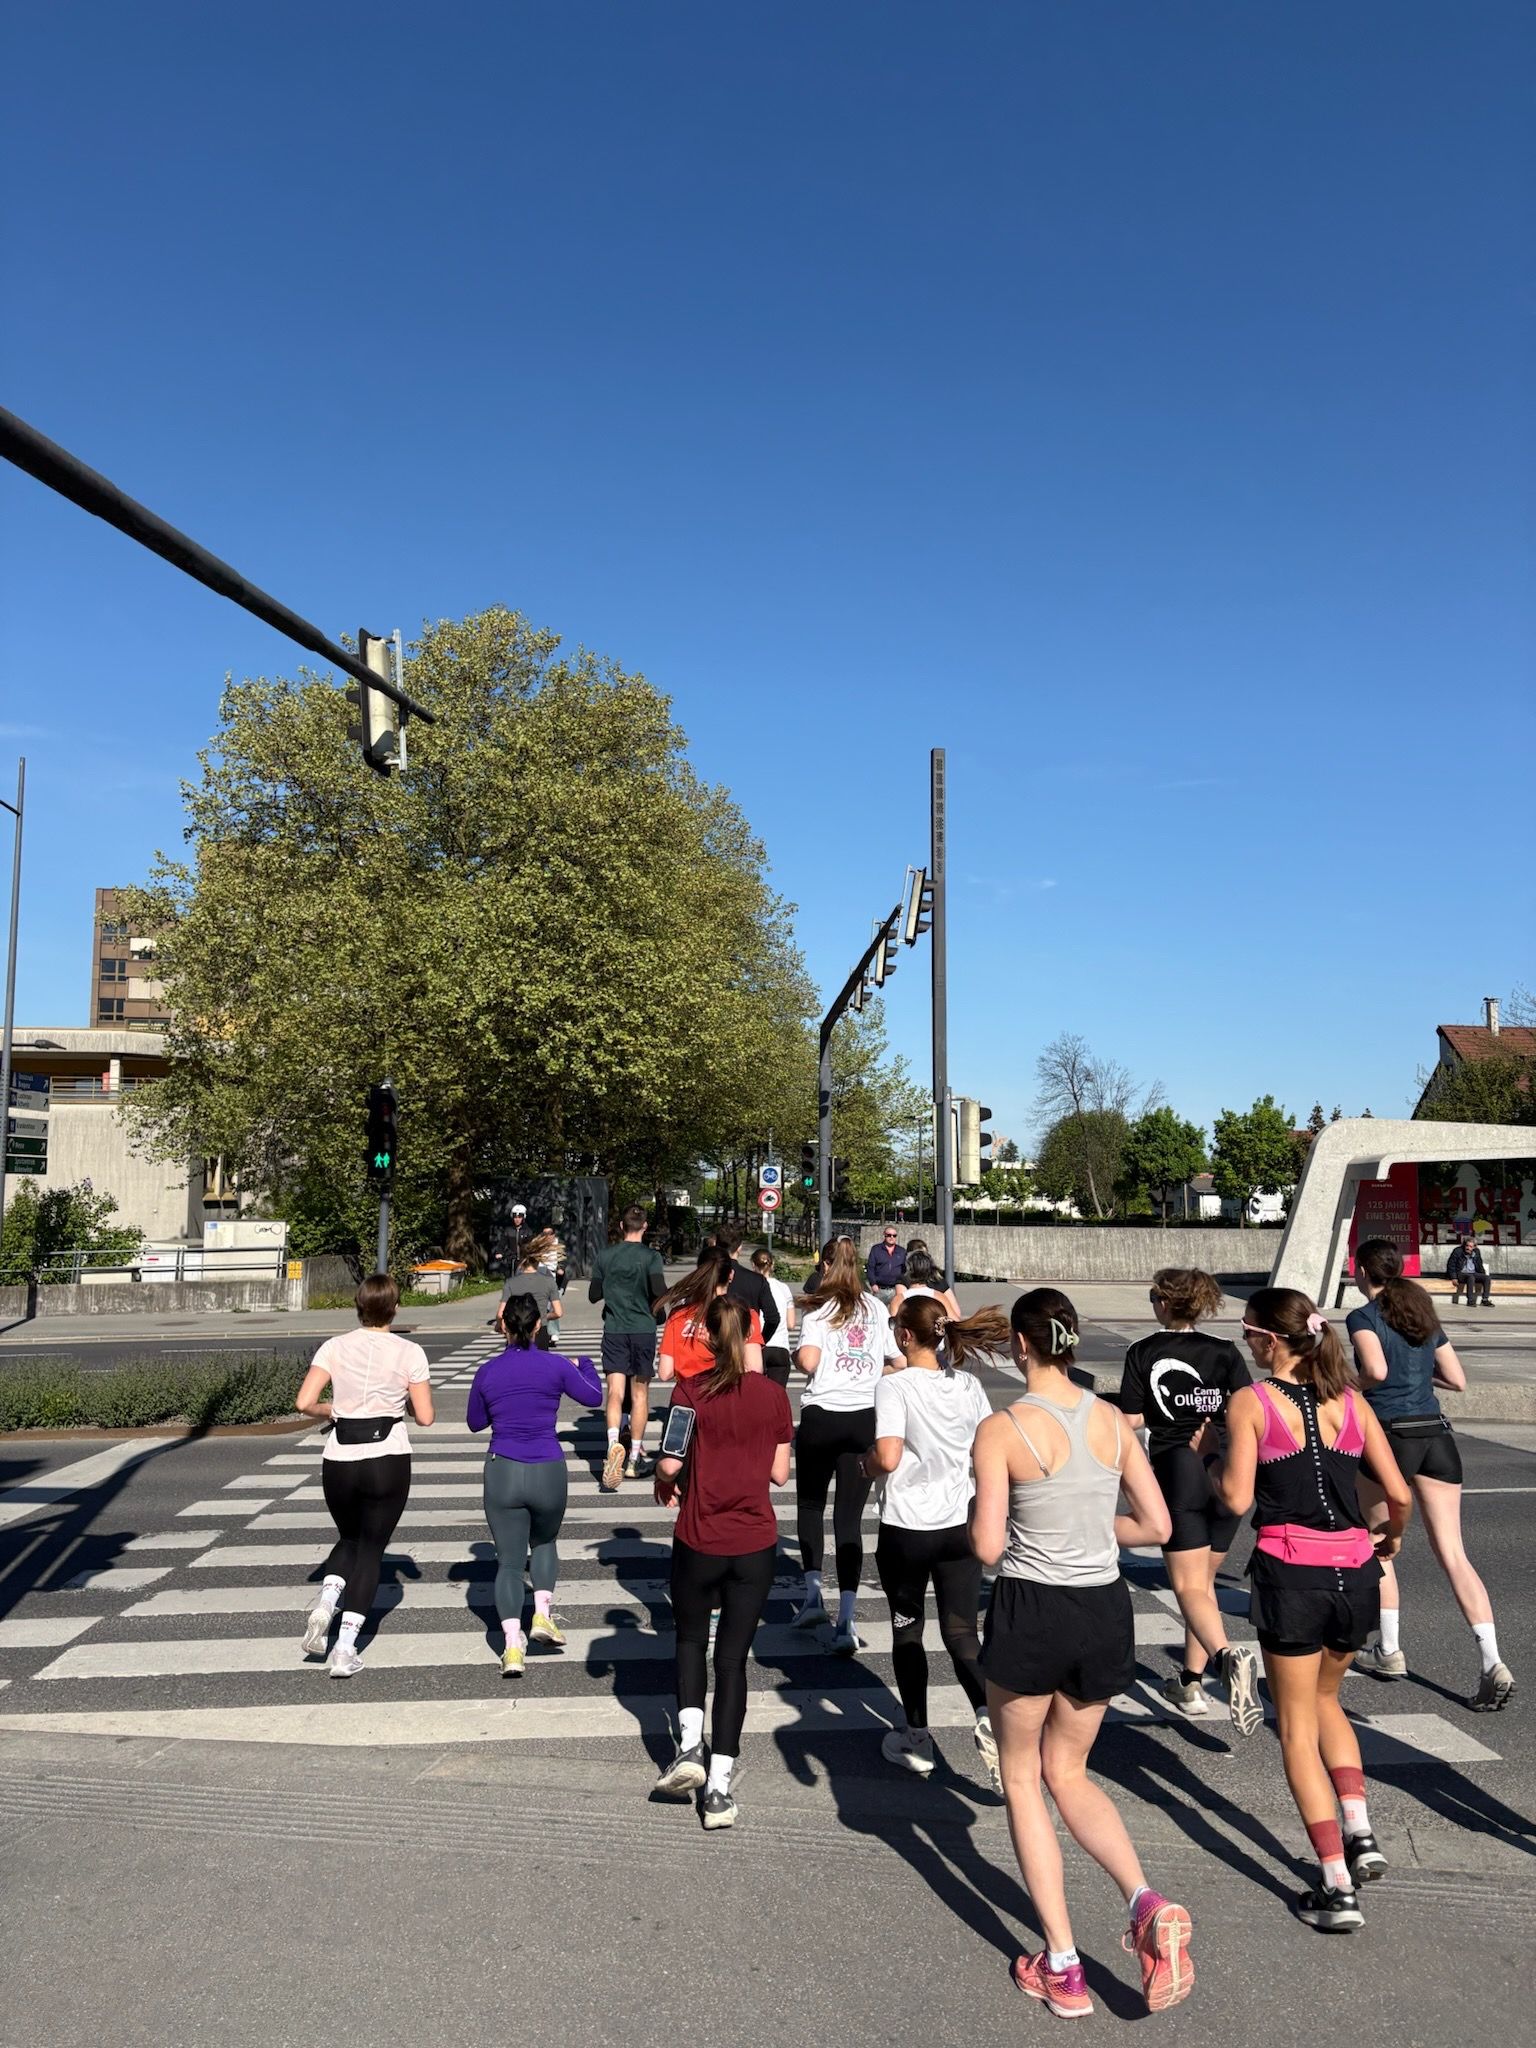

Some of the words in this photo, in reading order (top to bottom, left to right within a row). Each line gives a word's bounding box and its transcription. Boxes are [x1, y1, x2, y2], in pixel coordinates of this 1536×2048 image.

[1368, 1200, 1383, 1209] 125
[1365, 1211, 1384, 1221] EINE
[1385, 1211, 1412, 1221] STADT.
[1390, 1223, 1413, 1232] VIELE
[1193, 1386, 1221, 1396] Camp
[1174, 1394, 1223, 1407] Ollerup
[1196, 1404, 1218, 1413] 2019
[1303, 1396, 1315, 1431] ARMOUR
[1311, 1437, 1320, 1466] UNDER
